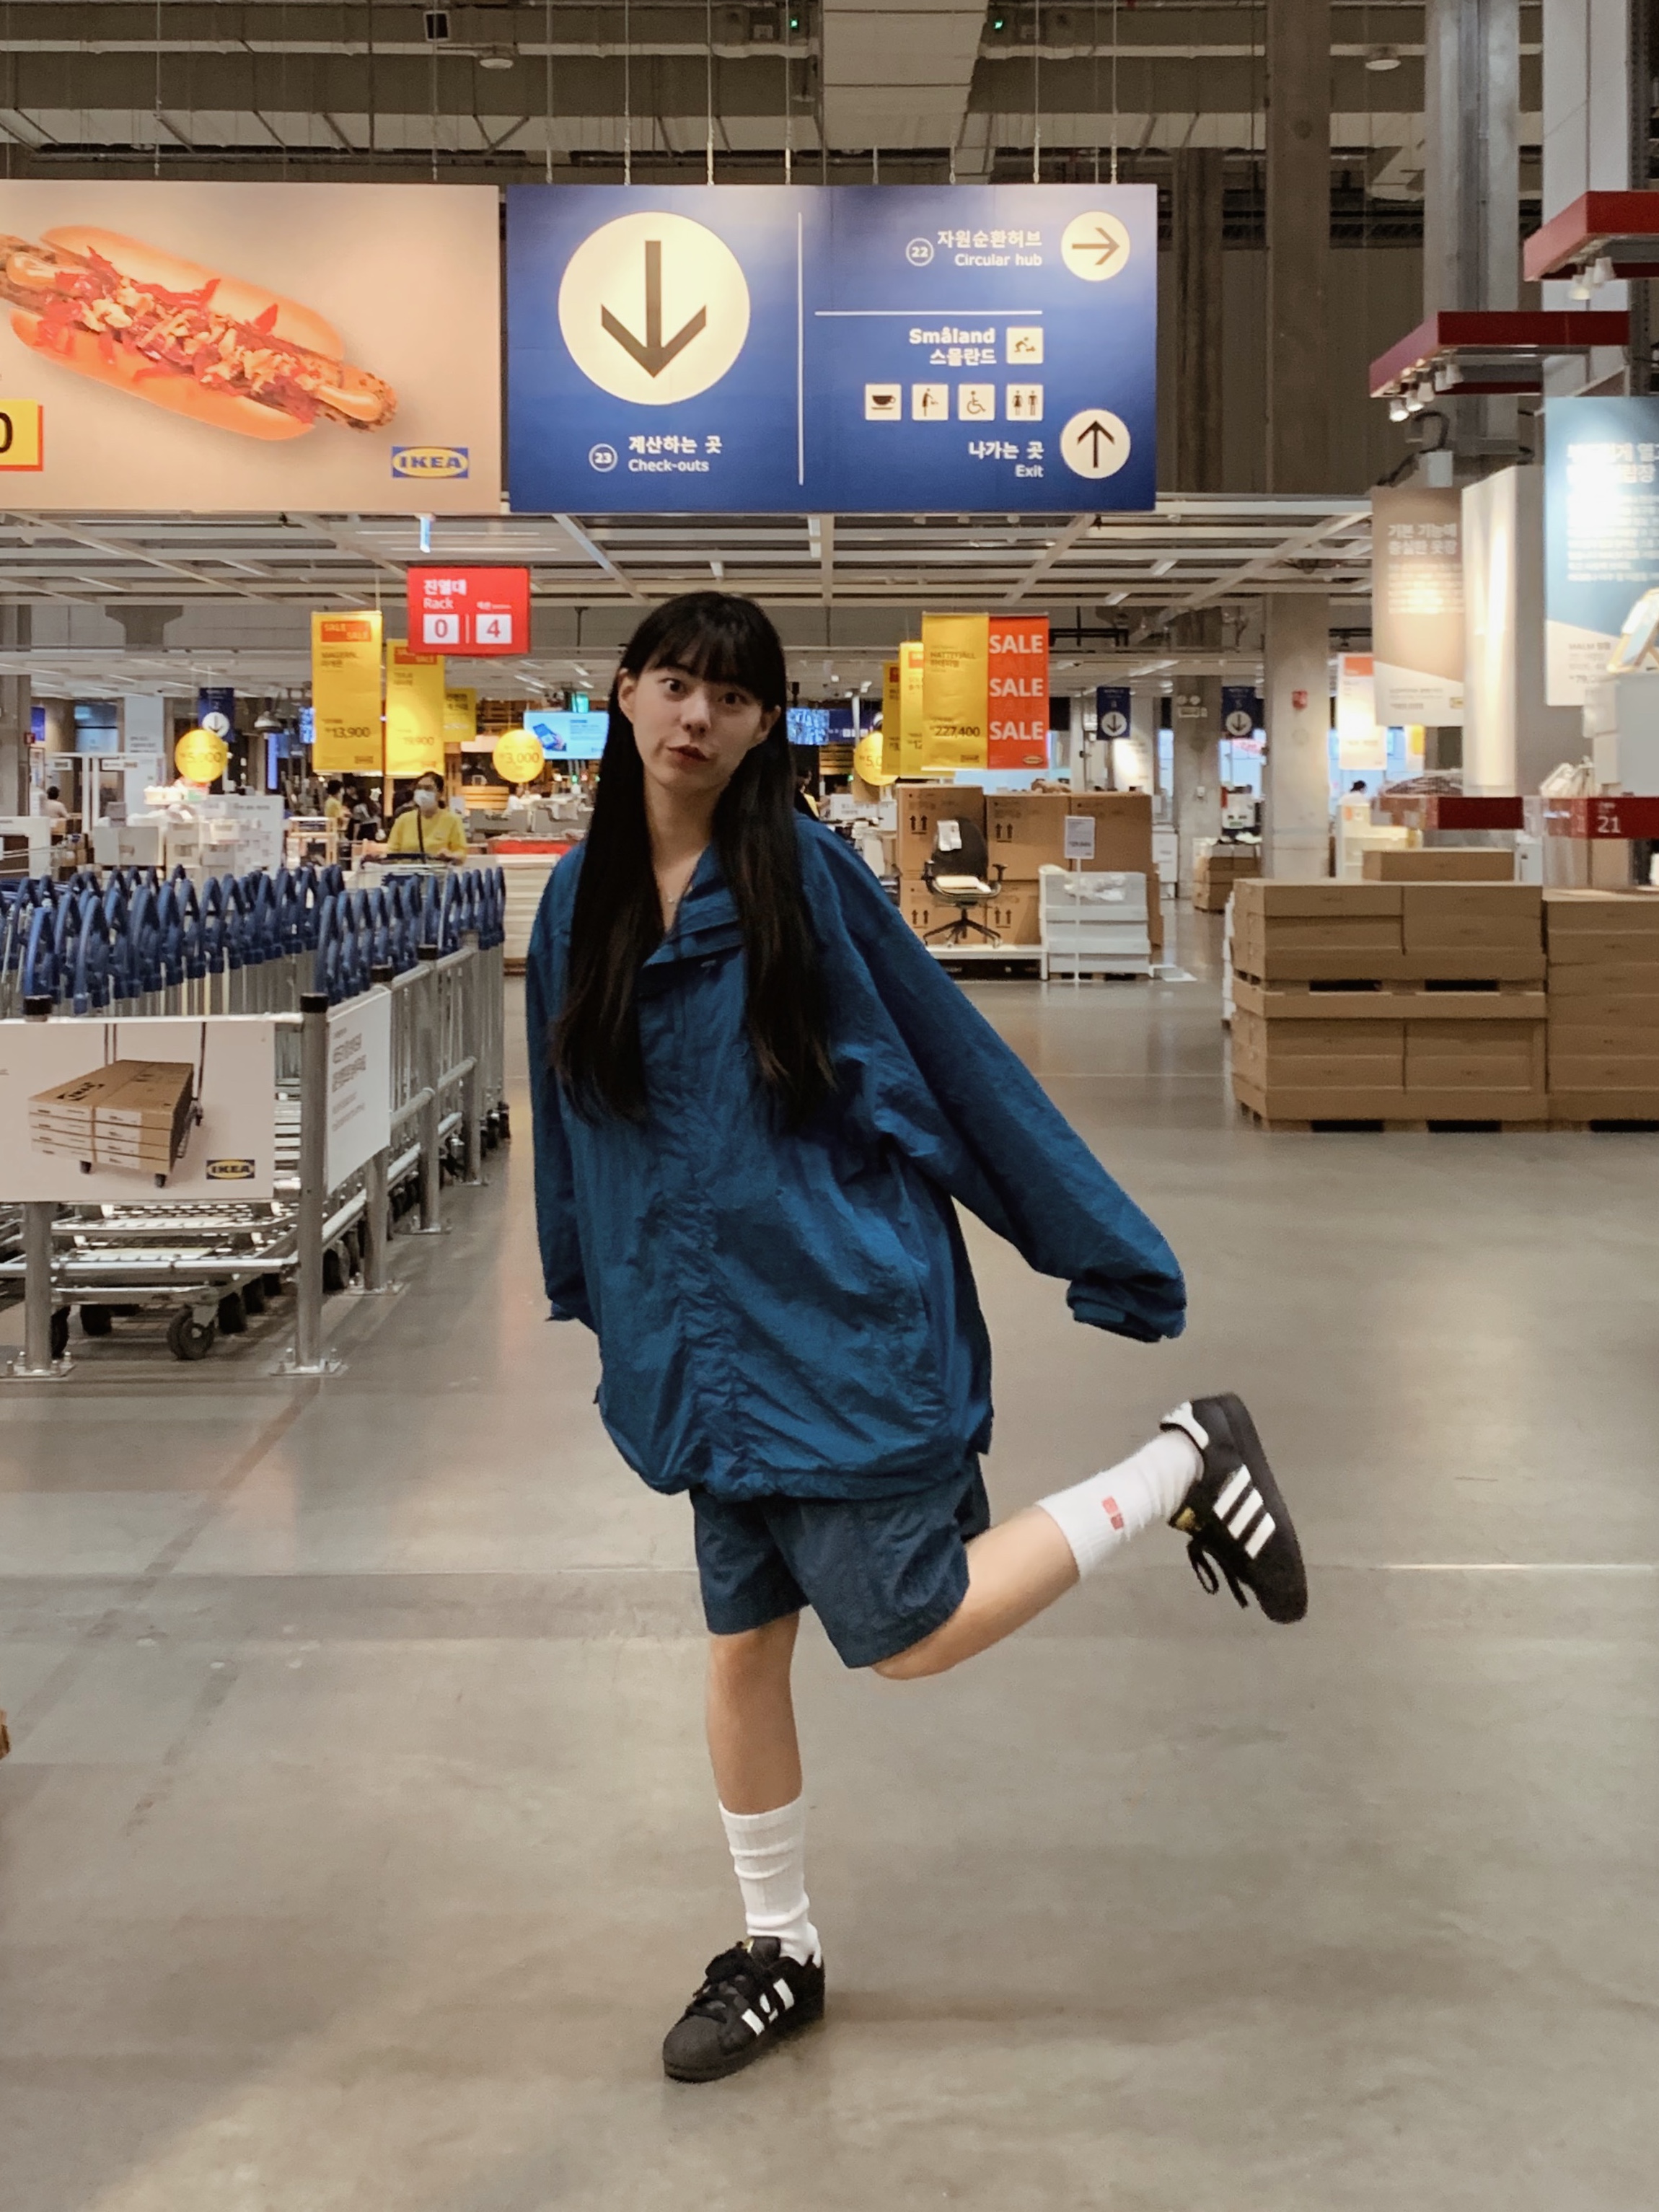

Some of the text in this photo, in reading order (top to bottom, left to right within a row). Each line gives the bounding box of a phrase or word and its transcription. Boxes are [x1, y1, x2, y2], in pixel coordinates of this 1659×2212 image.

[937, 229, 1043, 249] 자원순환허브
[911, 246, 929, 258] 22
[954, 253, 1042, 267] Circular hub
[909, 326, 995, 345] Småland
[628, 435, 723, 455] 계산하는 곳
[968, 441, 1044, 460] 나가는 곳
[400, 456, 462, 469] IKEA
[594, 452, 613, 464] 23
[628, 458, 710, 473] Check-outs
[1015, 464, 1044, 478] Exit
[423, 597, 454, 610] Rack
[434, 618, 448, 638] 0
[486, 619, 501, 638] 4
[989, 634, 1044, 654] SALE
[989, 677, 1044, 698] SALE
[989, 721, 1044, 741] SALE
[1596, 815, 1621, 834] 21
[211, 1164, 250, 1174] IKEA
